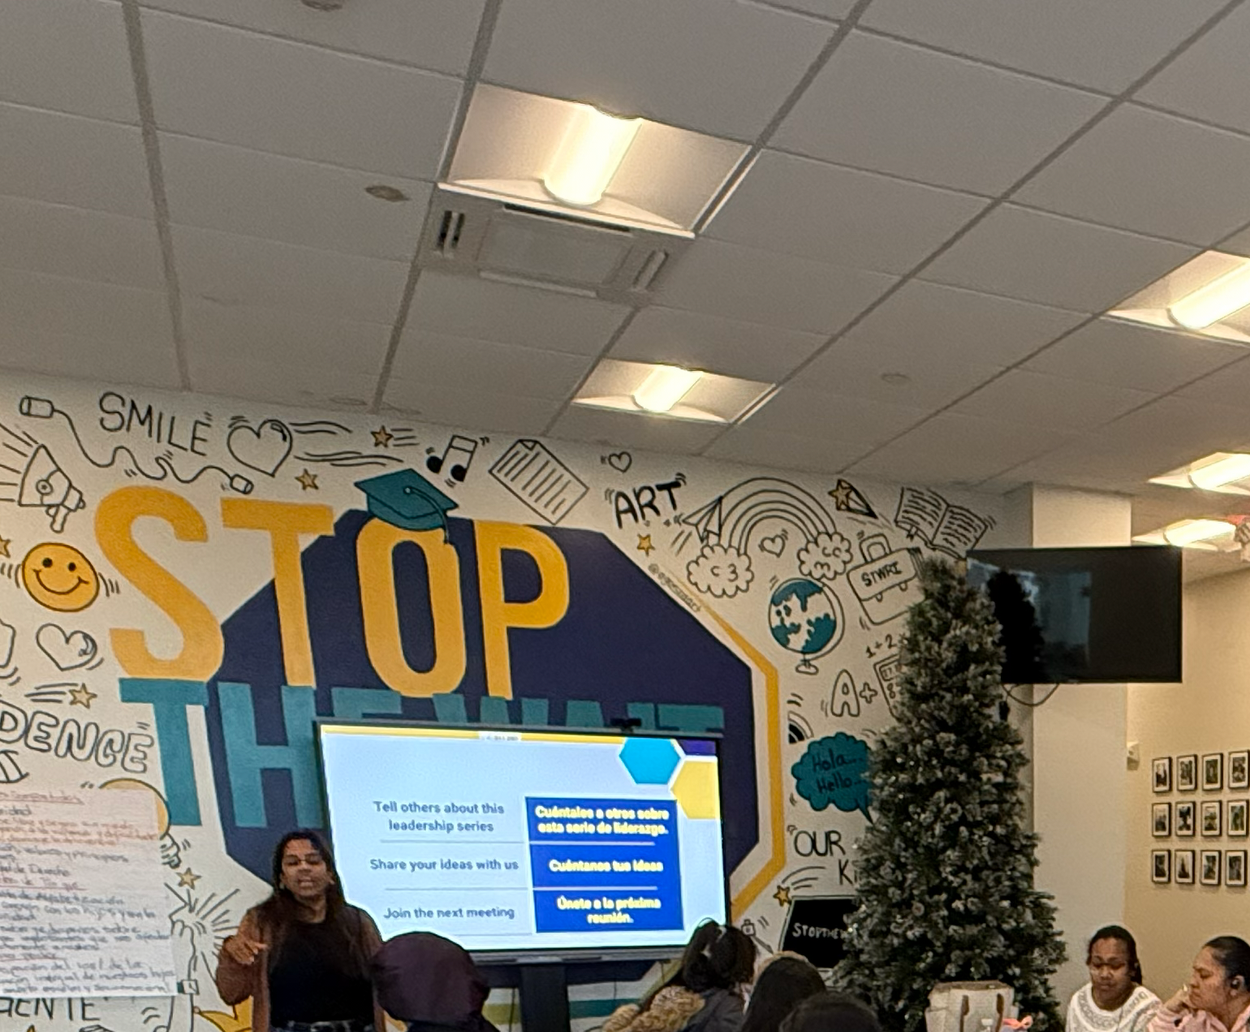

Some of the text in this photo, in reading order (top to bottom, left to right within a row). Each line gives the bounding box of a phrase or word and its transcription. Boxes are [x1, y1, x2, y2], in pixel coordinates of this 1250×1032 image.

[98, 392, 212, 456] SMILE
[612, 481, 684, 529] ART
[94, 485, 570, 700] STOP
[118, 677, 403, 829] TH
[373, 801, 505, 815] Tell others about this
[605, 808, 635, 819] otros
[637, 807, 670, 820] sobre
[388, 819, 494, 834] leadership series
[596, 821, 612, 834] de
[794, 829, 847, 857] OUR
[370, 858, 519, 873] Share your ideas with us
[383, 906, 516, 920] Join the next meeting
